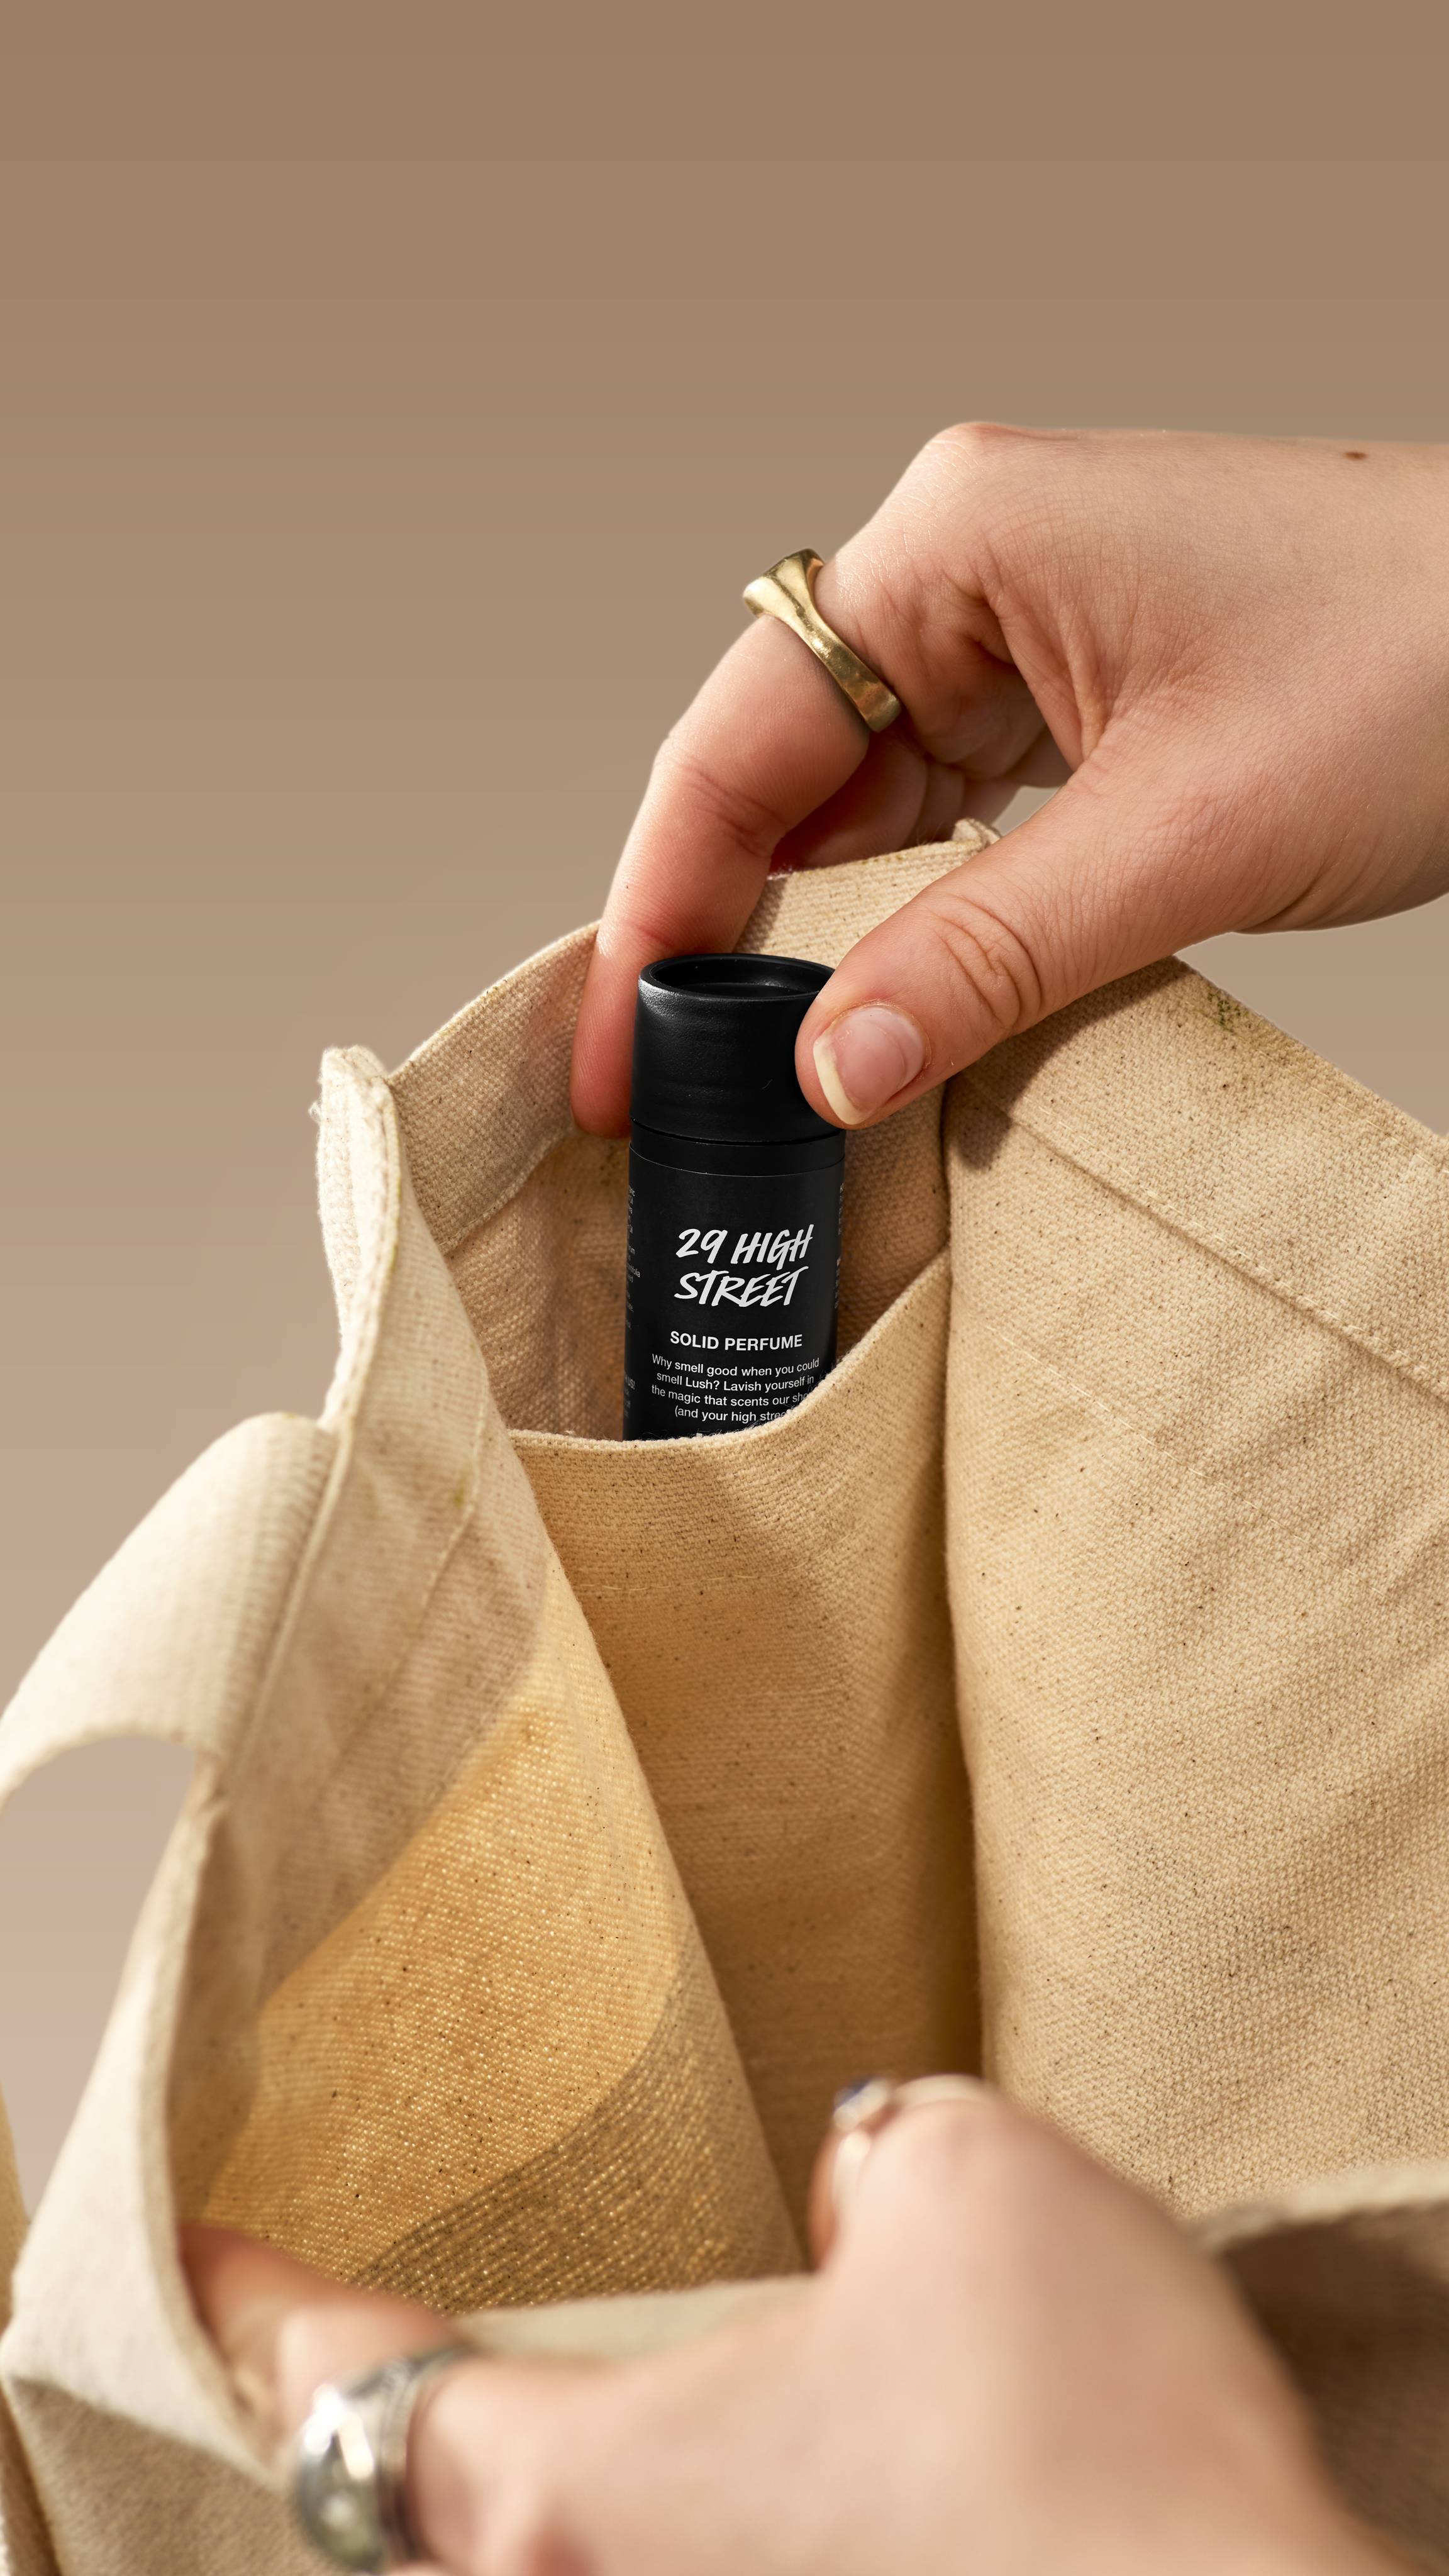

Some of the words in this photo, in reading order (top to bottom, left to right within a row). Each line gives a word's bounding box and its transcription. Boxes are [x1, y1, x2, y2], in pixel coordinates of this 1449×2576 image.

[676, 1229, 728, 1263] 29
[731, 1224, 814, 1270] HIGH
[674, 1266, 809, 1307] STREET
[670, 1331, 719, 1349] SOLID
[725, 1335, 802, 1350] PERFUME
[652, 1354, 672, 1370] Why
[675, 1362, 703, 1373] smell
[707, 1367, 737, 1377] good
[741, 1367, 772, 1376] when
[775, 1366, 794, 1377] you
[797, 1358, 819, 1372] could
[657, 1373, 682, 1385] smell
[686, 1377, 719, 1390] Lush?
[724, 1381, 761, 1391] Lavish
[765, 1376, 805, 1393] yourself
[808, 1375, 813, 1384] in
[652, 1385, 665, 1396] the
[669, 1391, 700, 1404] magic
[704, 1395, 727, 1406] that
[731, 1397, 769, 1406] scents
[772, 1396, 789, 1405] our
[675, 1406, 698, 1418] (and
[702, 1412, 728, 1421] your
[731, 1411, 757, 1424] high
